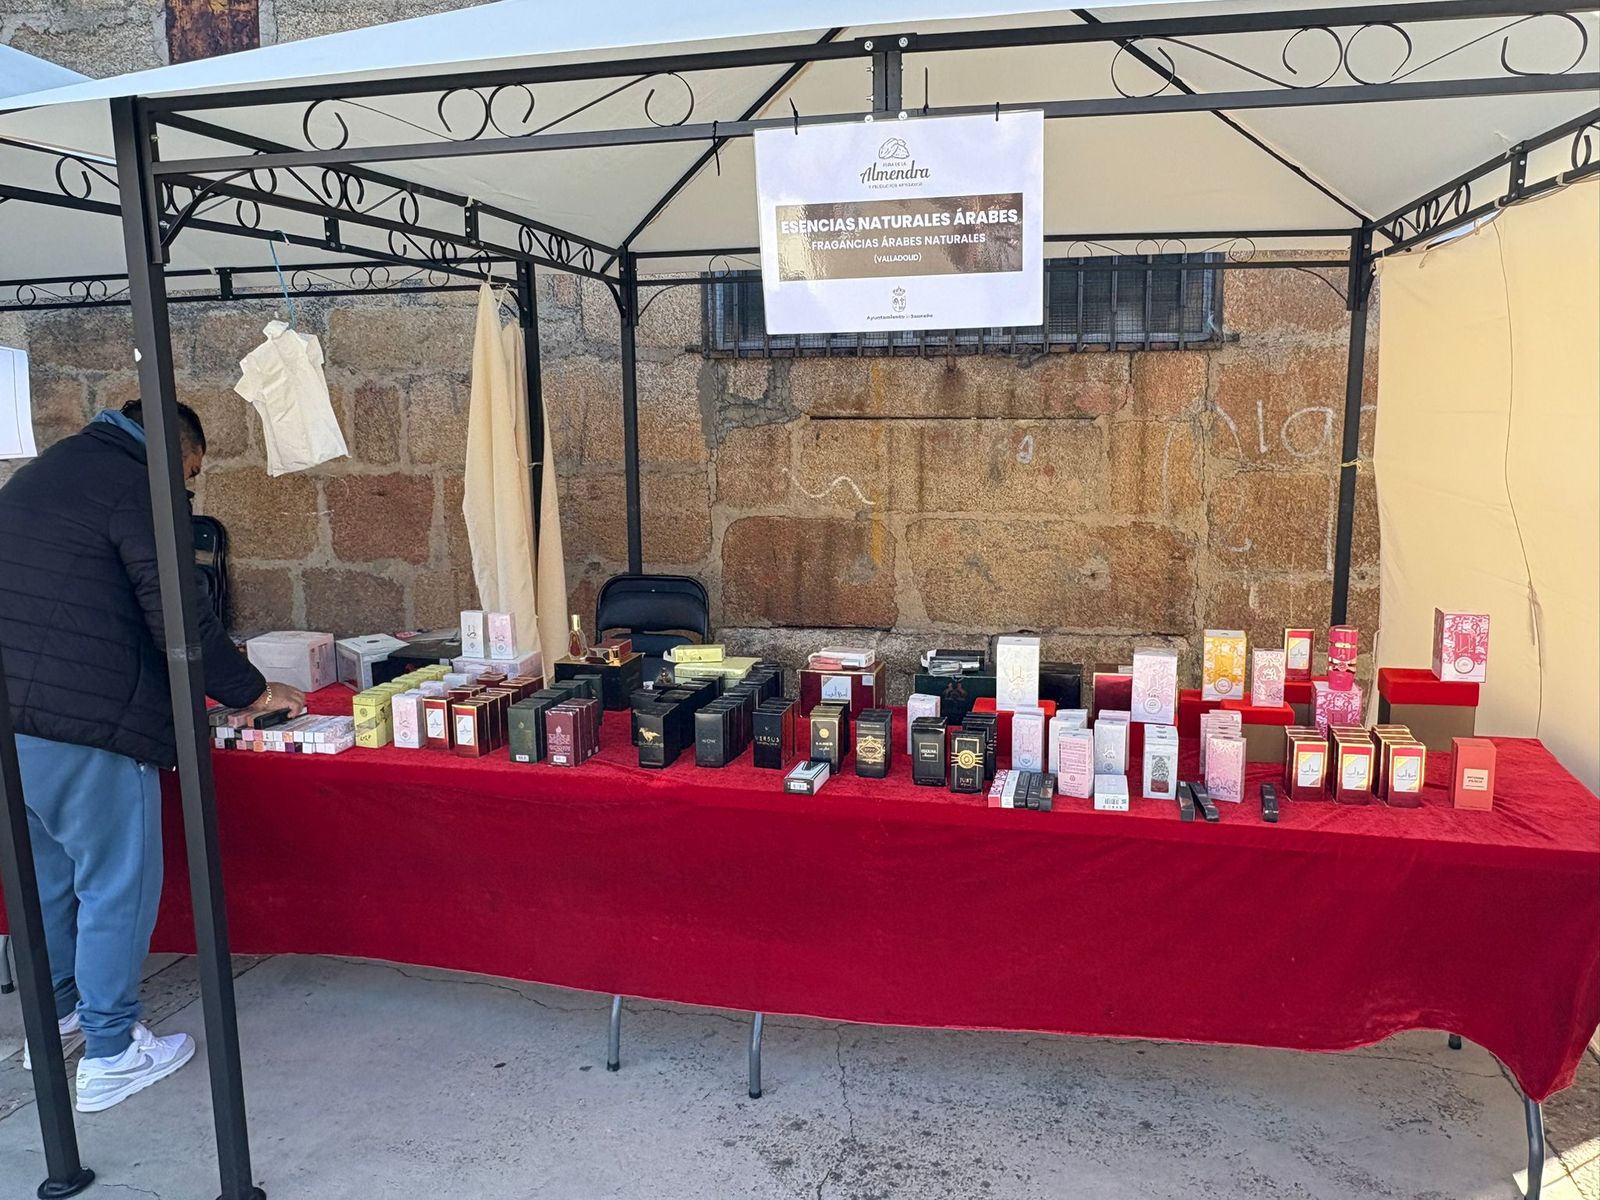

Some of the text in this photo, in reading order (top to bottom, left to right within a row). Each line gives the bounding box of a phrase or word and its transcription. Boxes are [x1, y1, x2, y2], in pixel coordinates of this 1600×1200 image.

[860, 159, 930, 184] Almendra
[781, 208, 1018, 234] ESENCIAS NATURALES ÁRABES
[812, 233, 986, 251] FRAGANCIAS ÁRABES NATURALES
[754, 735, 780, 743] VERSUS
